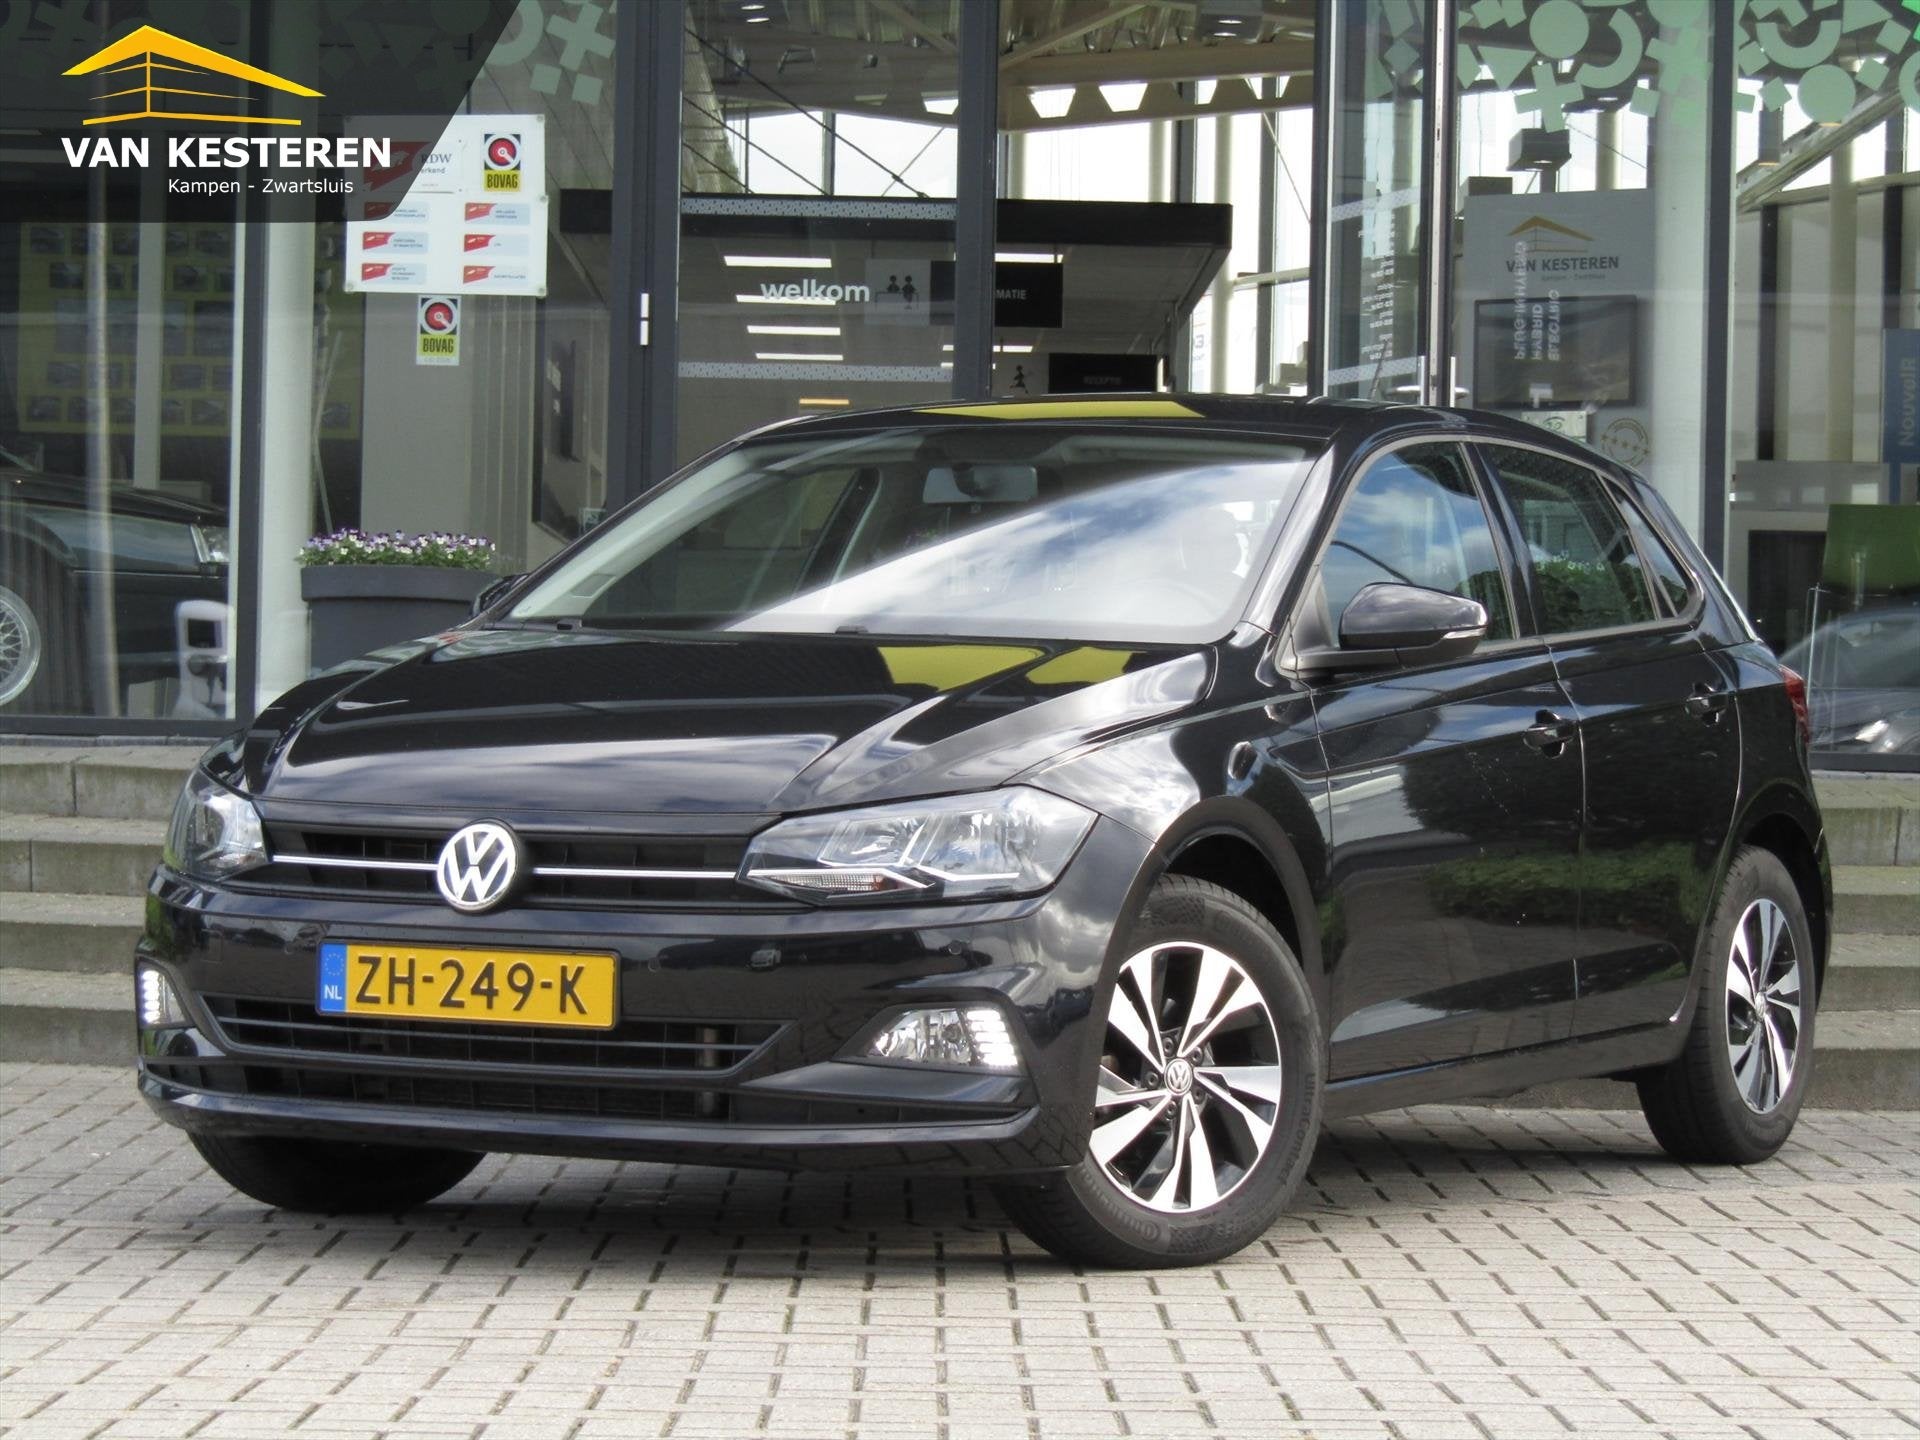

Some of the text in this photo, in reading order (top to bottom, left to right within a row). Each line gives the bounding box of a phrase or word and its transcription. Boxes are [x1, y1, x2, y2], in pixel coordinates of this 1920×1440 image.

[486, 173, 519, 190] BOVAG
[1541, 256, 1620, 272] KESTEREN
[759, 279, 870, 303] welkom
[994, 289, 1028, 300] MATIE
[422, 337, 454, 353] BOVAG
[323, 985, 343, 1000] NL
[355, 955, 588, 1015] ZH-249-K
